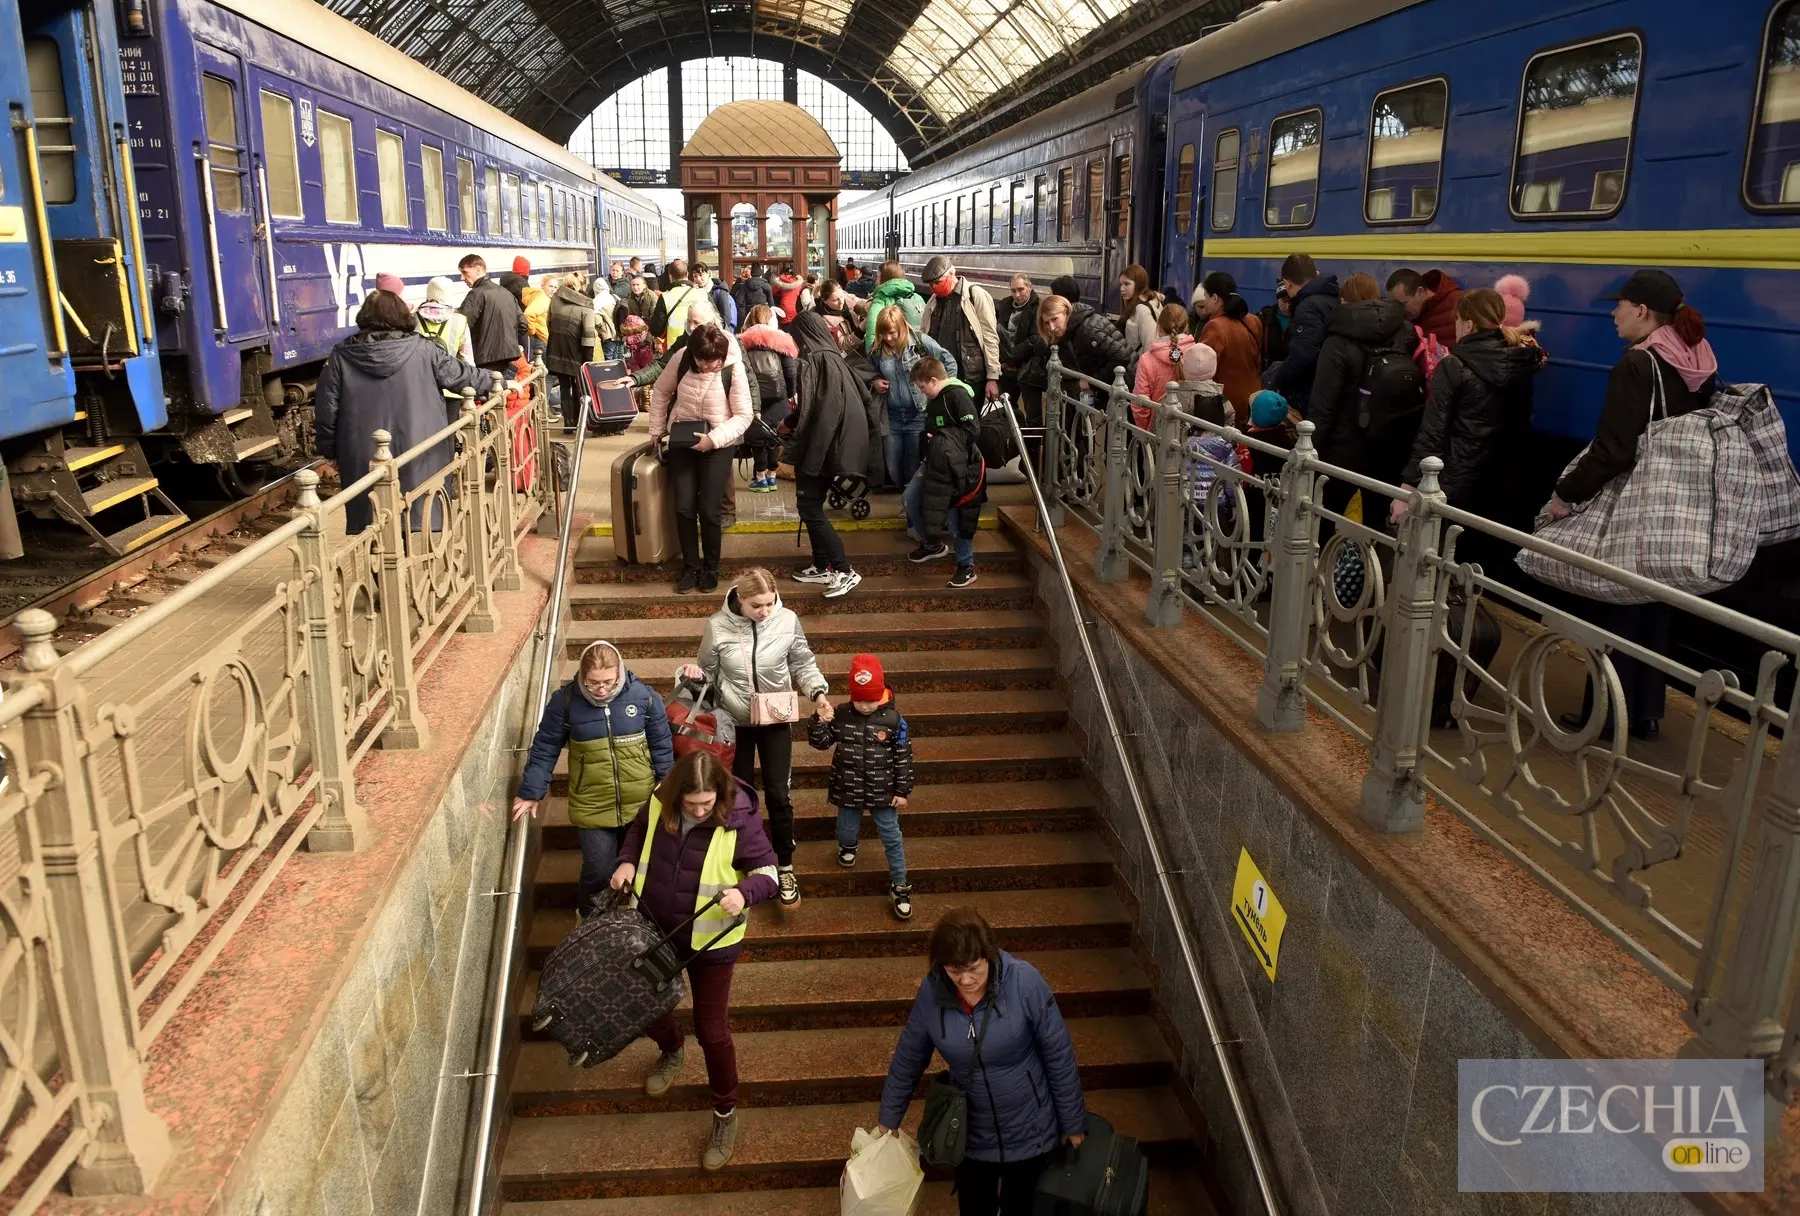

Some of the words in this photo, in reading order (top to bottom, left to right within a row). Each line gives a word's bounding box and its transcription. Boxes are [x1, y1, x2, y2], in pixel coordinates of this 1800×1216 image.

[141, 83, 155, 94] 23
[157, 208, 169, 219] 21
[1257, 886, 1265, 910] 1
